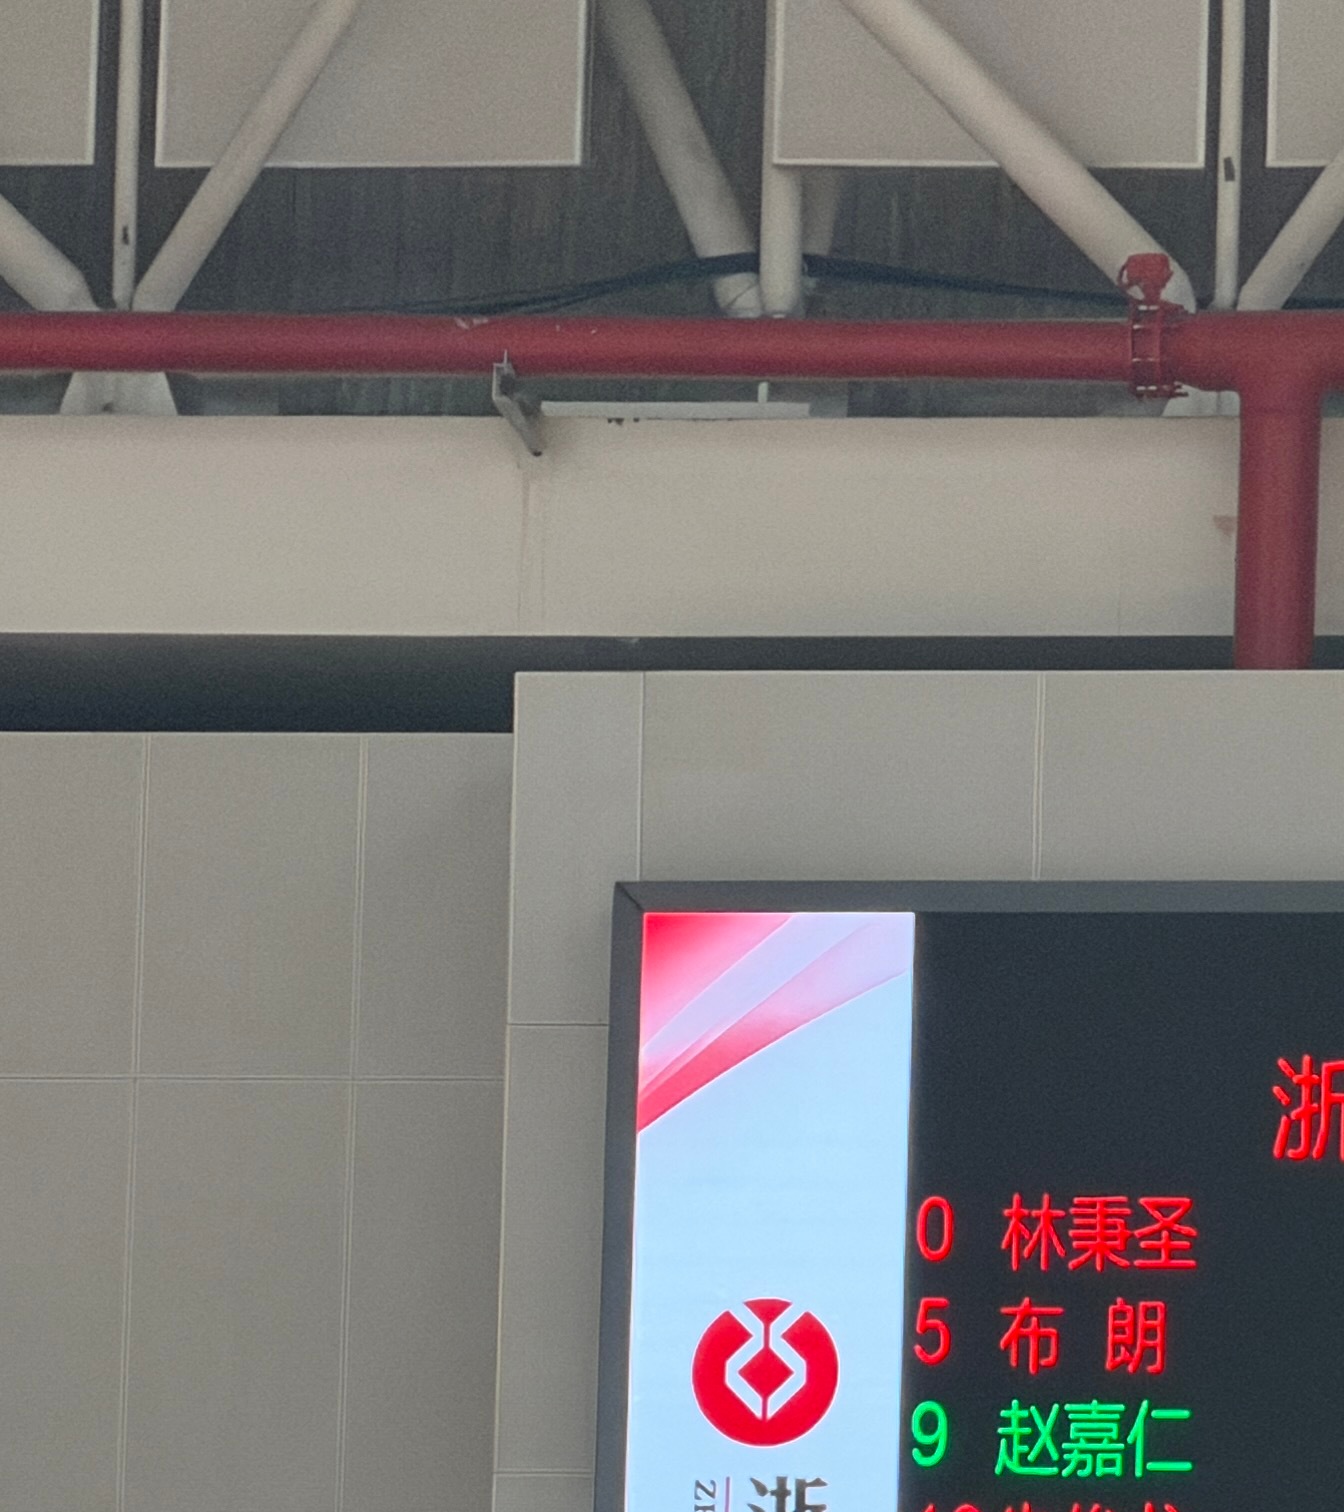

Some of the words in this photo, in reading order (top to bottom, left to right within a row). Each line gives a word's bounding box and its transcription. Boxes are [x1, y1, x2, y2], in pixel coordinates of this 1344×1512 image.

[915, 1195, 955, 1263] 0
[1001, 1193, 1198, 1272] 林秉圣
[913, 1297, 950, 1365] 5
[911, 1401, 947, 1467] 9
[995, 1399, 1192, 1477] 赵嘉仁
